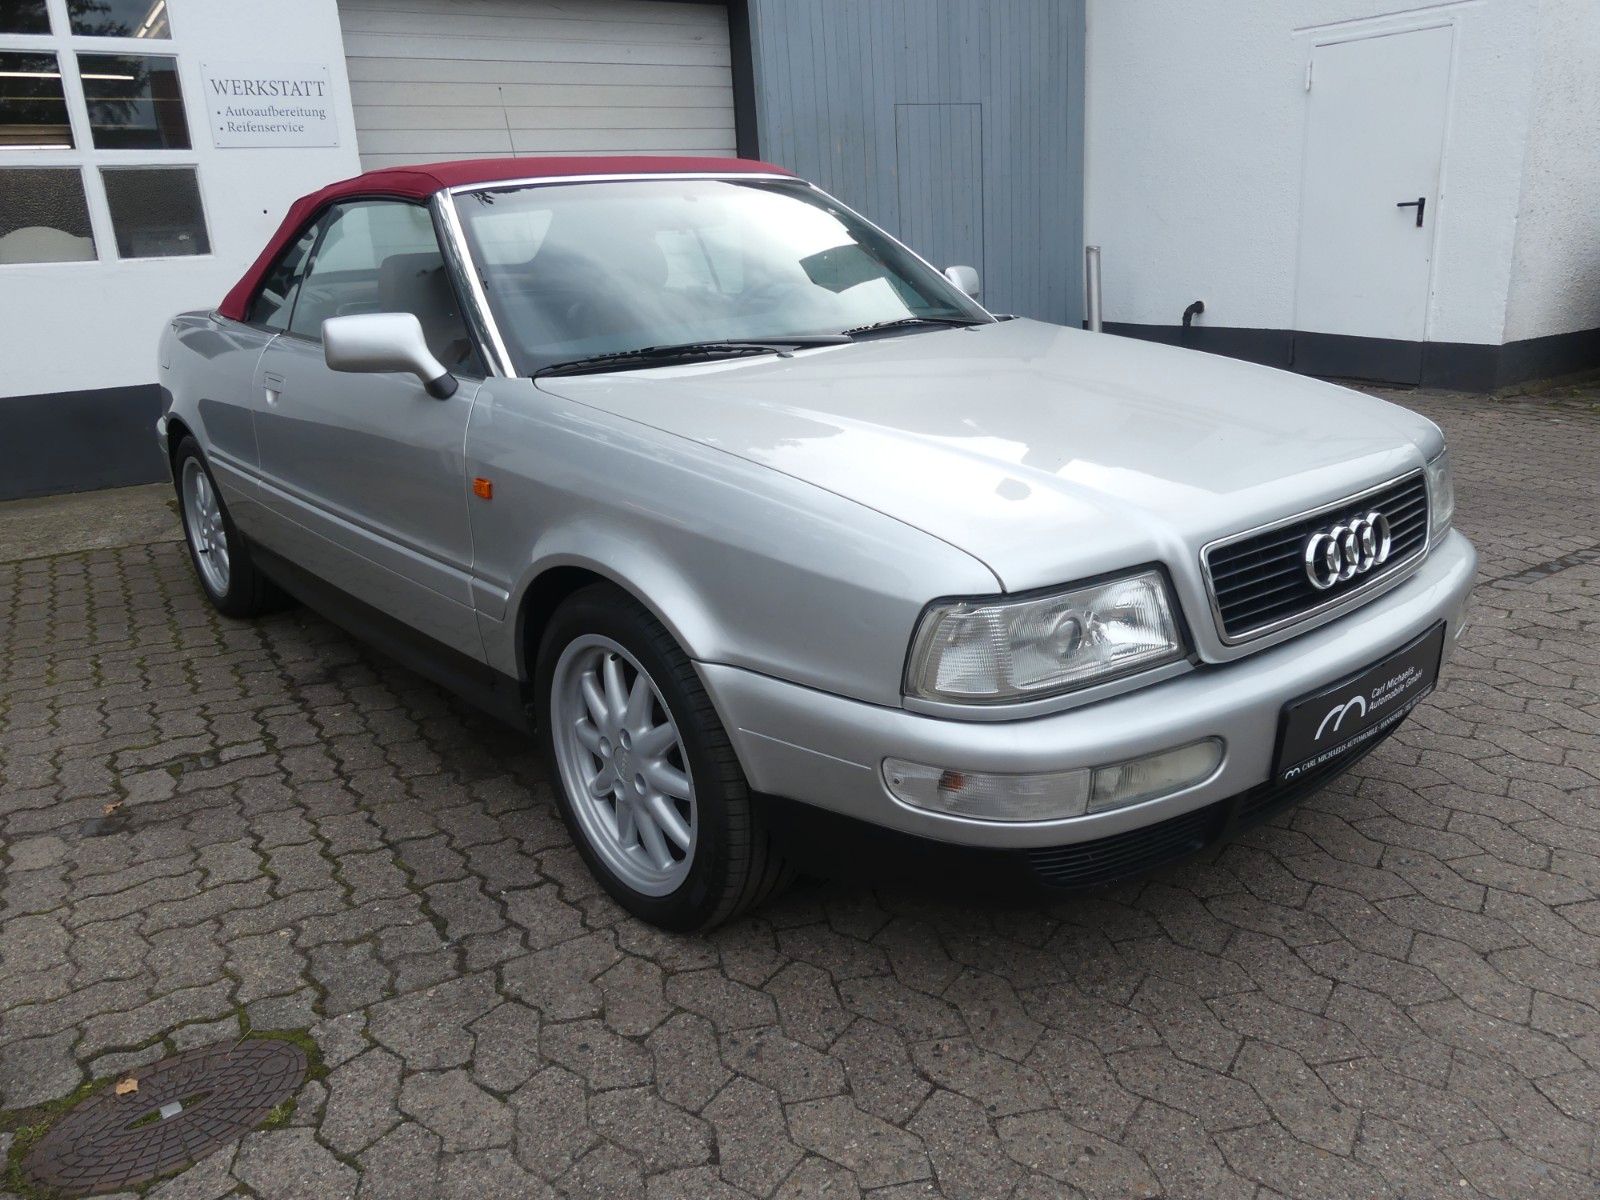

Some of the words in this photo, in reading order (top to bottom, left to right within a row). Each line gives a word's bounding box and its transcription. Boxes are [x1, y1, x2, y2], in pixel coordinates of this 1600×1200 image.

[210, 79, 325, 97] WERKSTATT
[225, 106, 327, 120] Autoaufbereitung
[227, 121, 304, 132] Reifenservice
[1367, 684, 1405, 712] Automobile
[1405, 668, 1423, 688] GmbH
[1371, 683, 1386, 699] Carl
[1386, 666, 1415, 690] Michaelis
[1301, 759, 1317, 771] CARL
[1317, 743, 1347, 763] MICHAELIS
